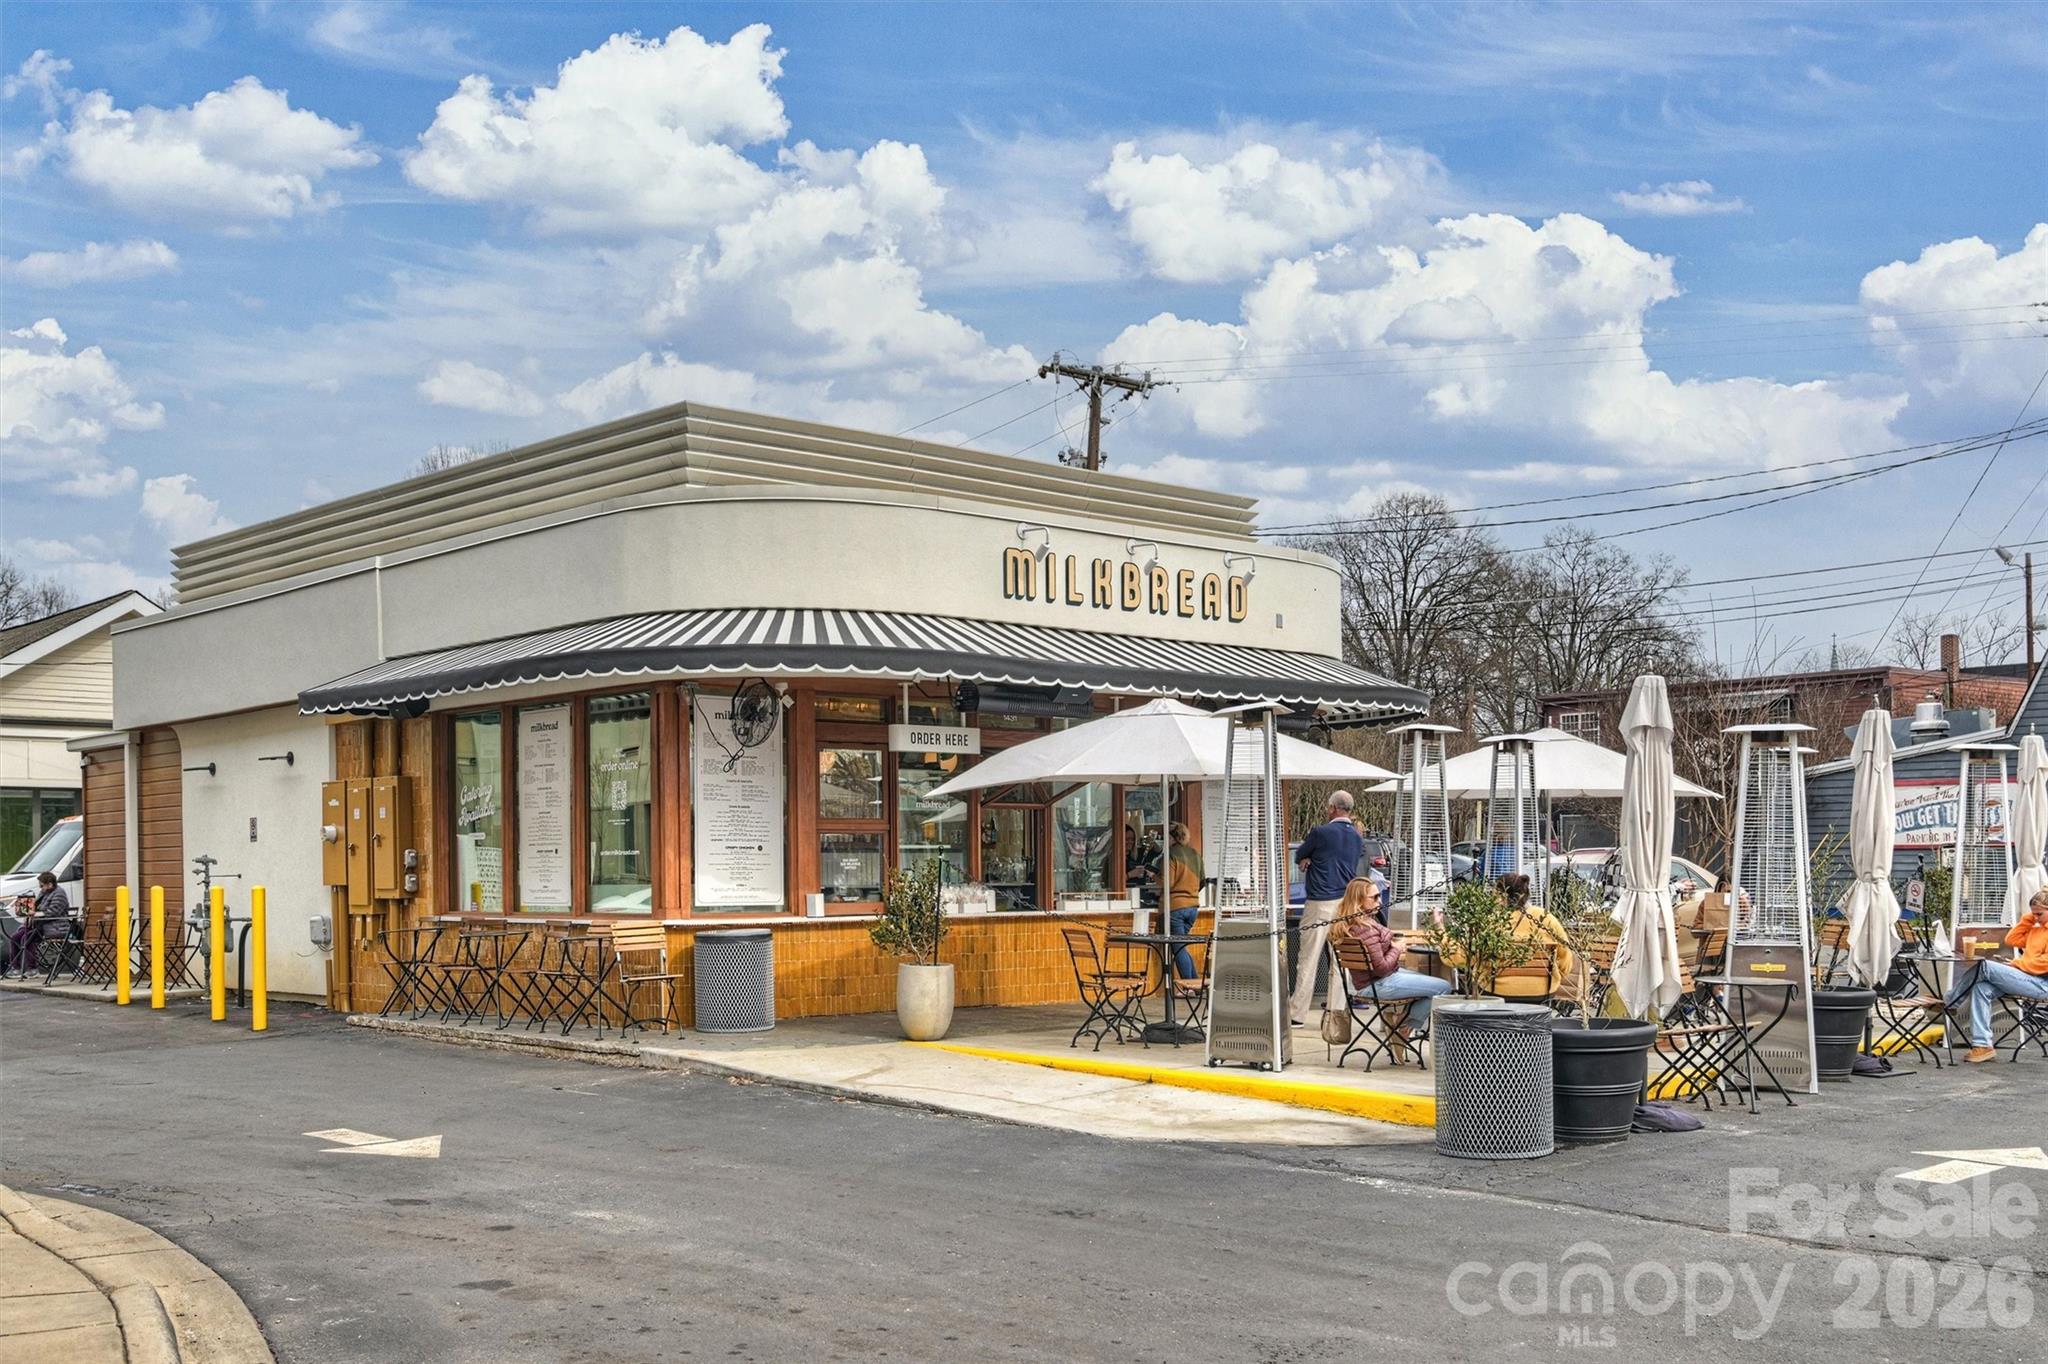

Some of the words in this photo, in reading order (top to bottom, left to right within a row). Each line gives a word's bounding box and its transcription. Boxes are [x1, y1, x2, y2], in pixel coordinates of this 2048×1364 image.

[1003, 547, 1249, 622] MILKBREAD
[530, 721, 559, 733] milkbread
[910, 731, 941, 746] ORDER
[945, 733, 969, 747] HERE
[600, 760, 618, 772] order
[618, 759, 640, 770] online
[460, 784, 493, 806] Catering
[915, 800, 951, 809] milkbread
[458, 802, 496, 826] Available
[1895, 812, 1915, 832] OW
[1917, 805, 1941, 826] GET
